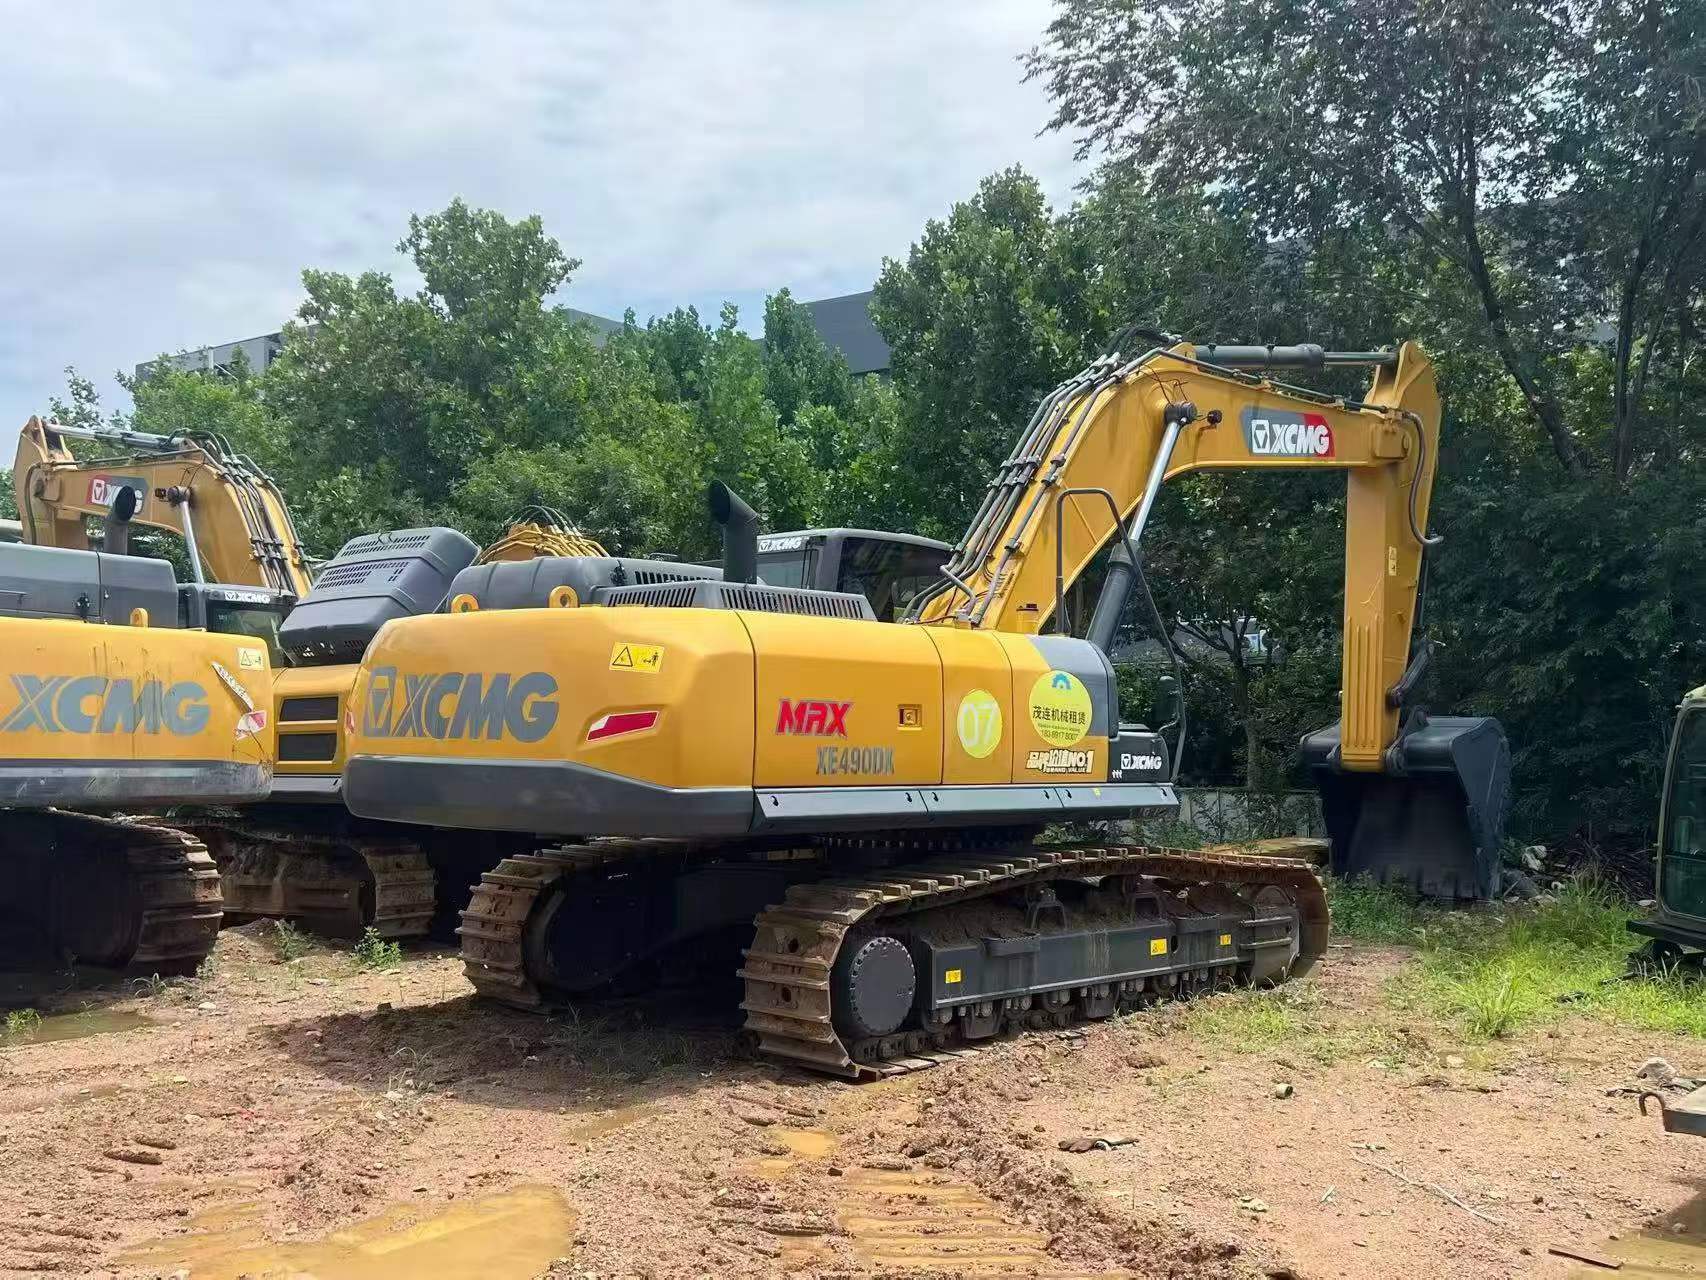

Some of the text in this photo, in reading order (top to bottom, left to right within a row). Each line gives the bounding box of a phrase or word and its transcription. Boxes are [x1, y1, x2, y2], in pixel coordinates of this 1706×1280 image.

[1270, 424, 1330, 455] XCMG
[0, 674, 210, 735] XCMG
[391, 672, 560, 743] XCMG
[776, 699, 853, 738] MAX
[1033, 705, 1087, 725] 茂连机械租赁
[959, 703, 998, 748] 07
[1131, 755, 1162, 770] XCMG
